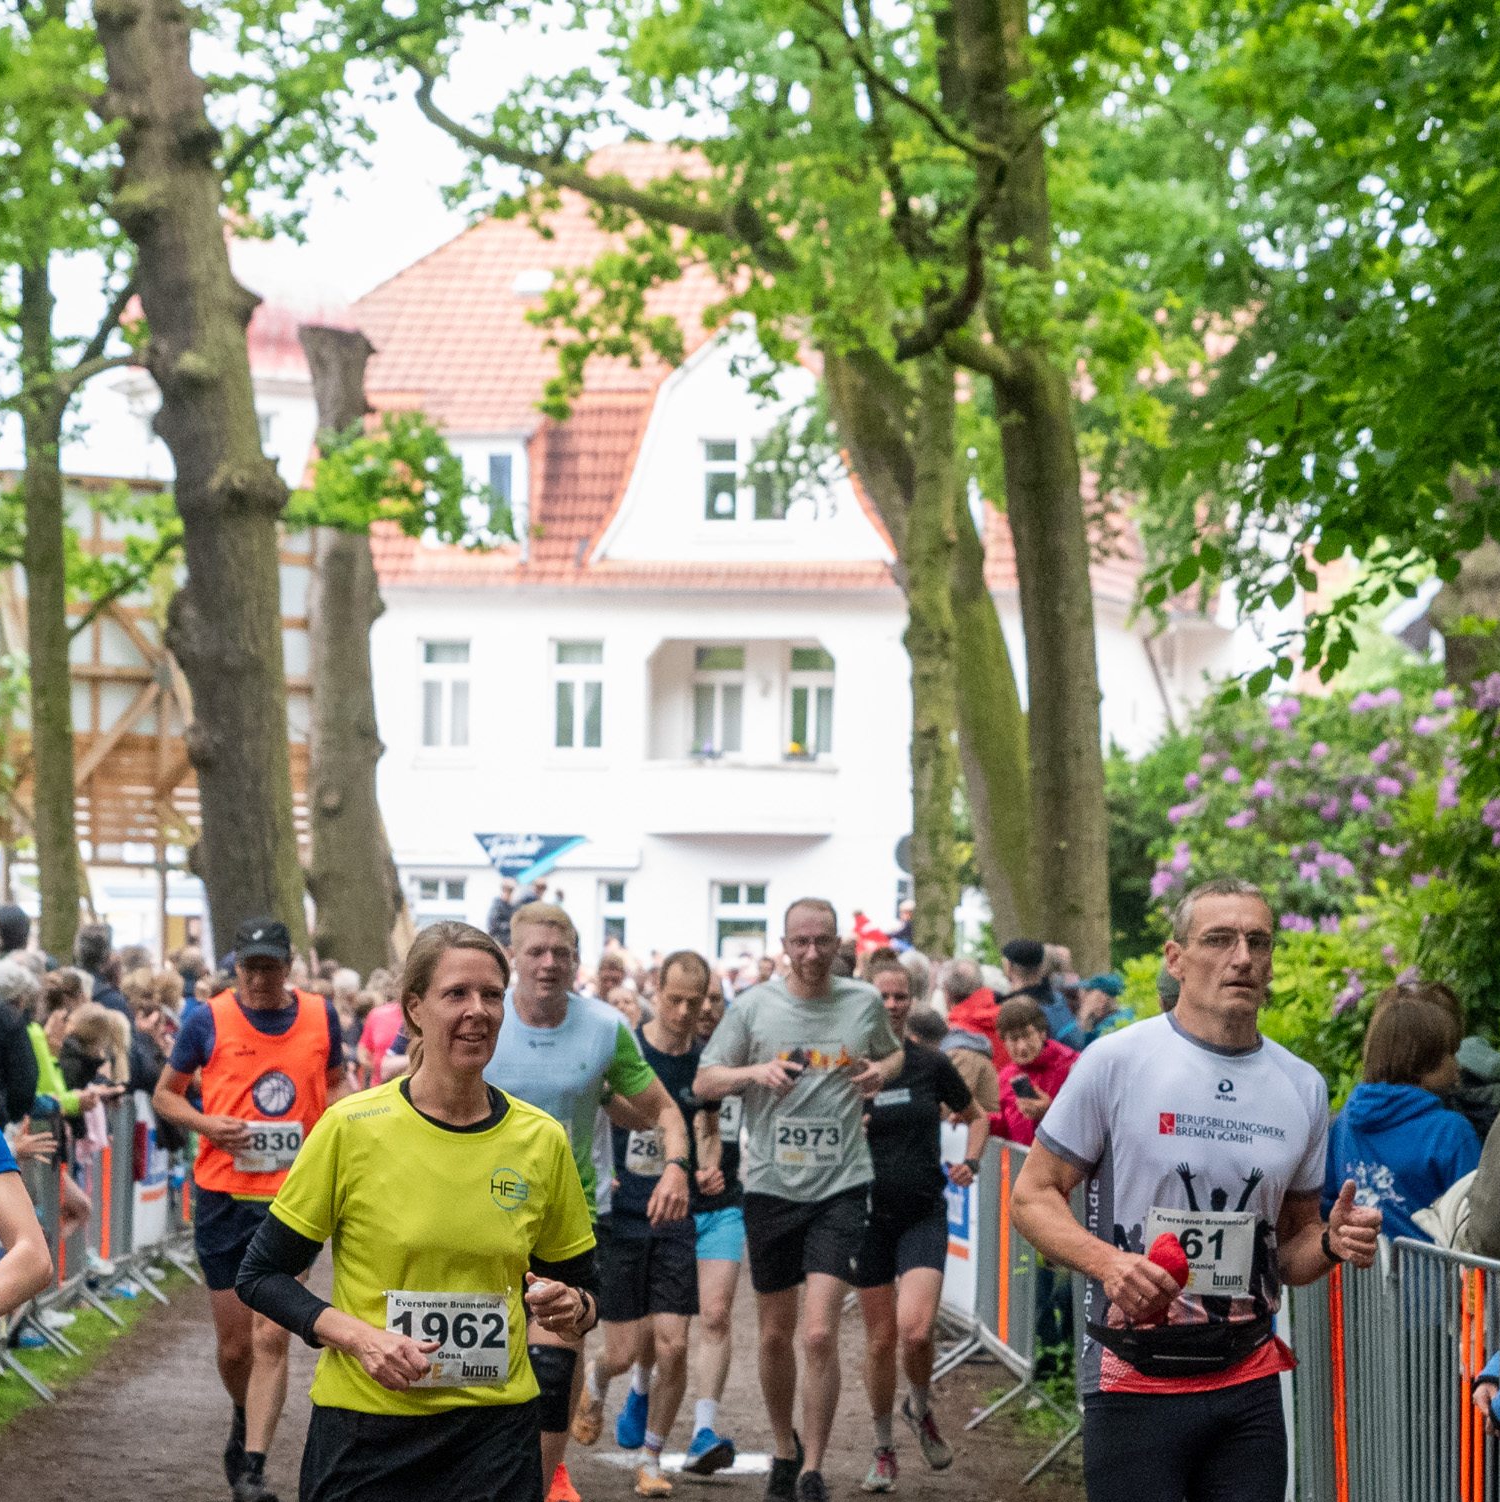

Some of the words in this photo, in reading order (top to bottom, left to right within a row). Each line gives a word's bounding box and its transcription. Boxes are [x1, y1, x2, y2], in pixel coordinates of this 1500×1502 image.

[347, 1105, 392, 1123] newline
[1175, 1113, 1287, 1139] BERUFSBILDUNGSWERK
[1175, 1126, 1216, 1140] BREMEN
[252, 1131, 301, 1152] 830
[778, 1126, 840, 1146] 2973
[1188, 1262, 1216, 1271] Daniel
[1212, 1271, 1243, 1286] bruns
[395, 1298, 448, 1309] Everstener
[449, 1300, 501, 1309] Brunnenlauf
[392, 1310, 506, 1349] 1962
[437, 1351, 462, 1360] Gesa
[461, 1361, 499, 1378] bruns
